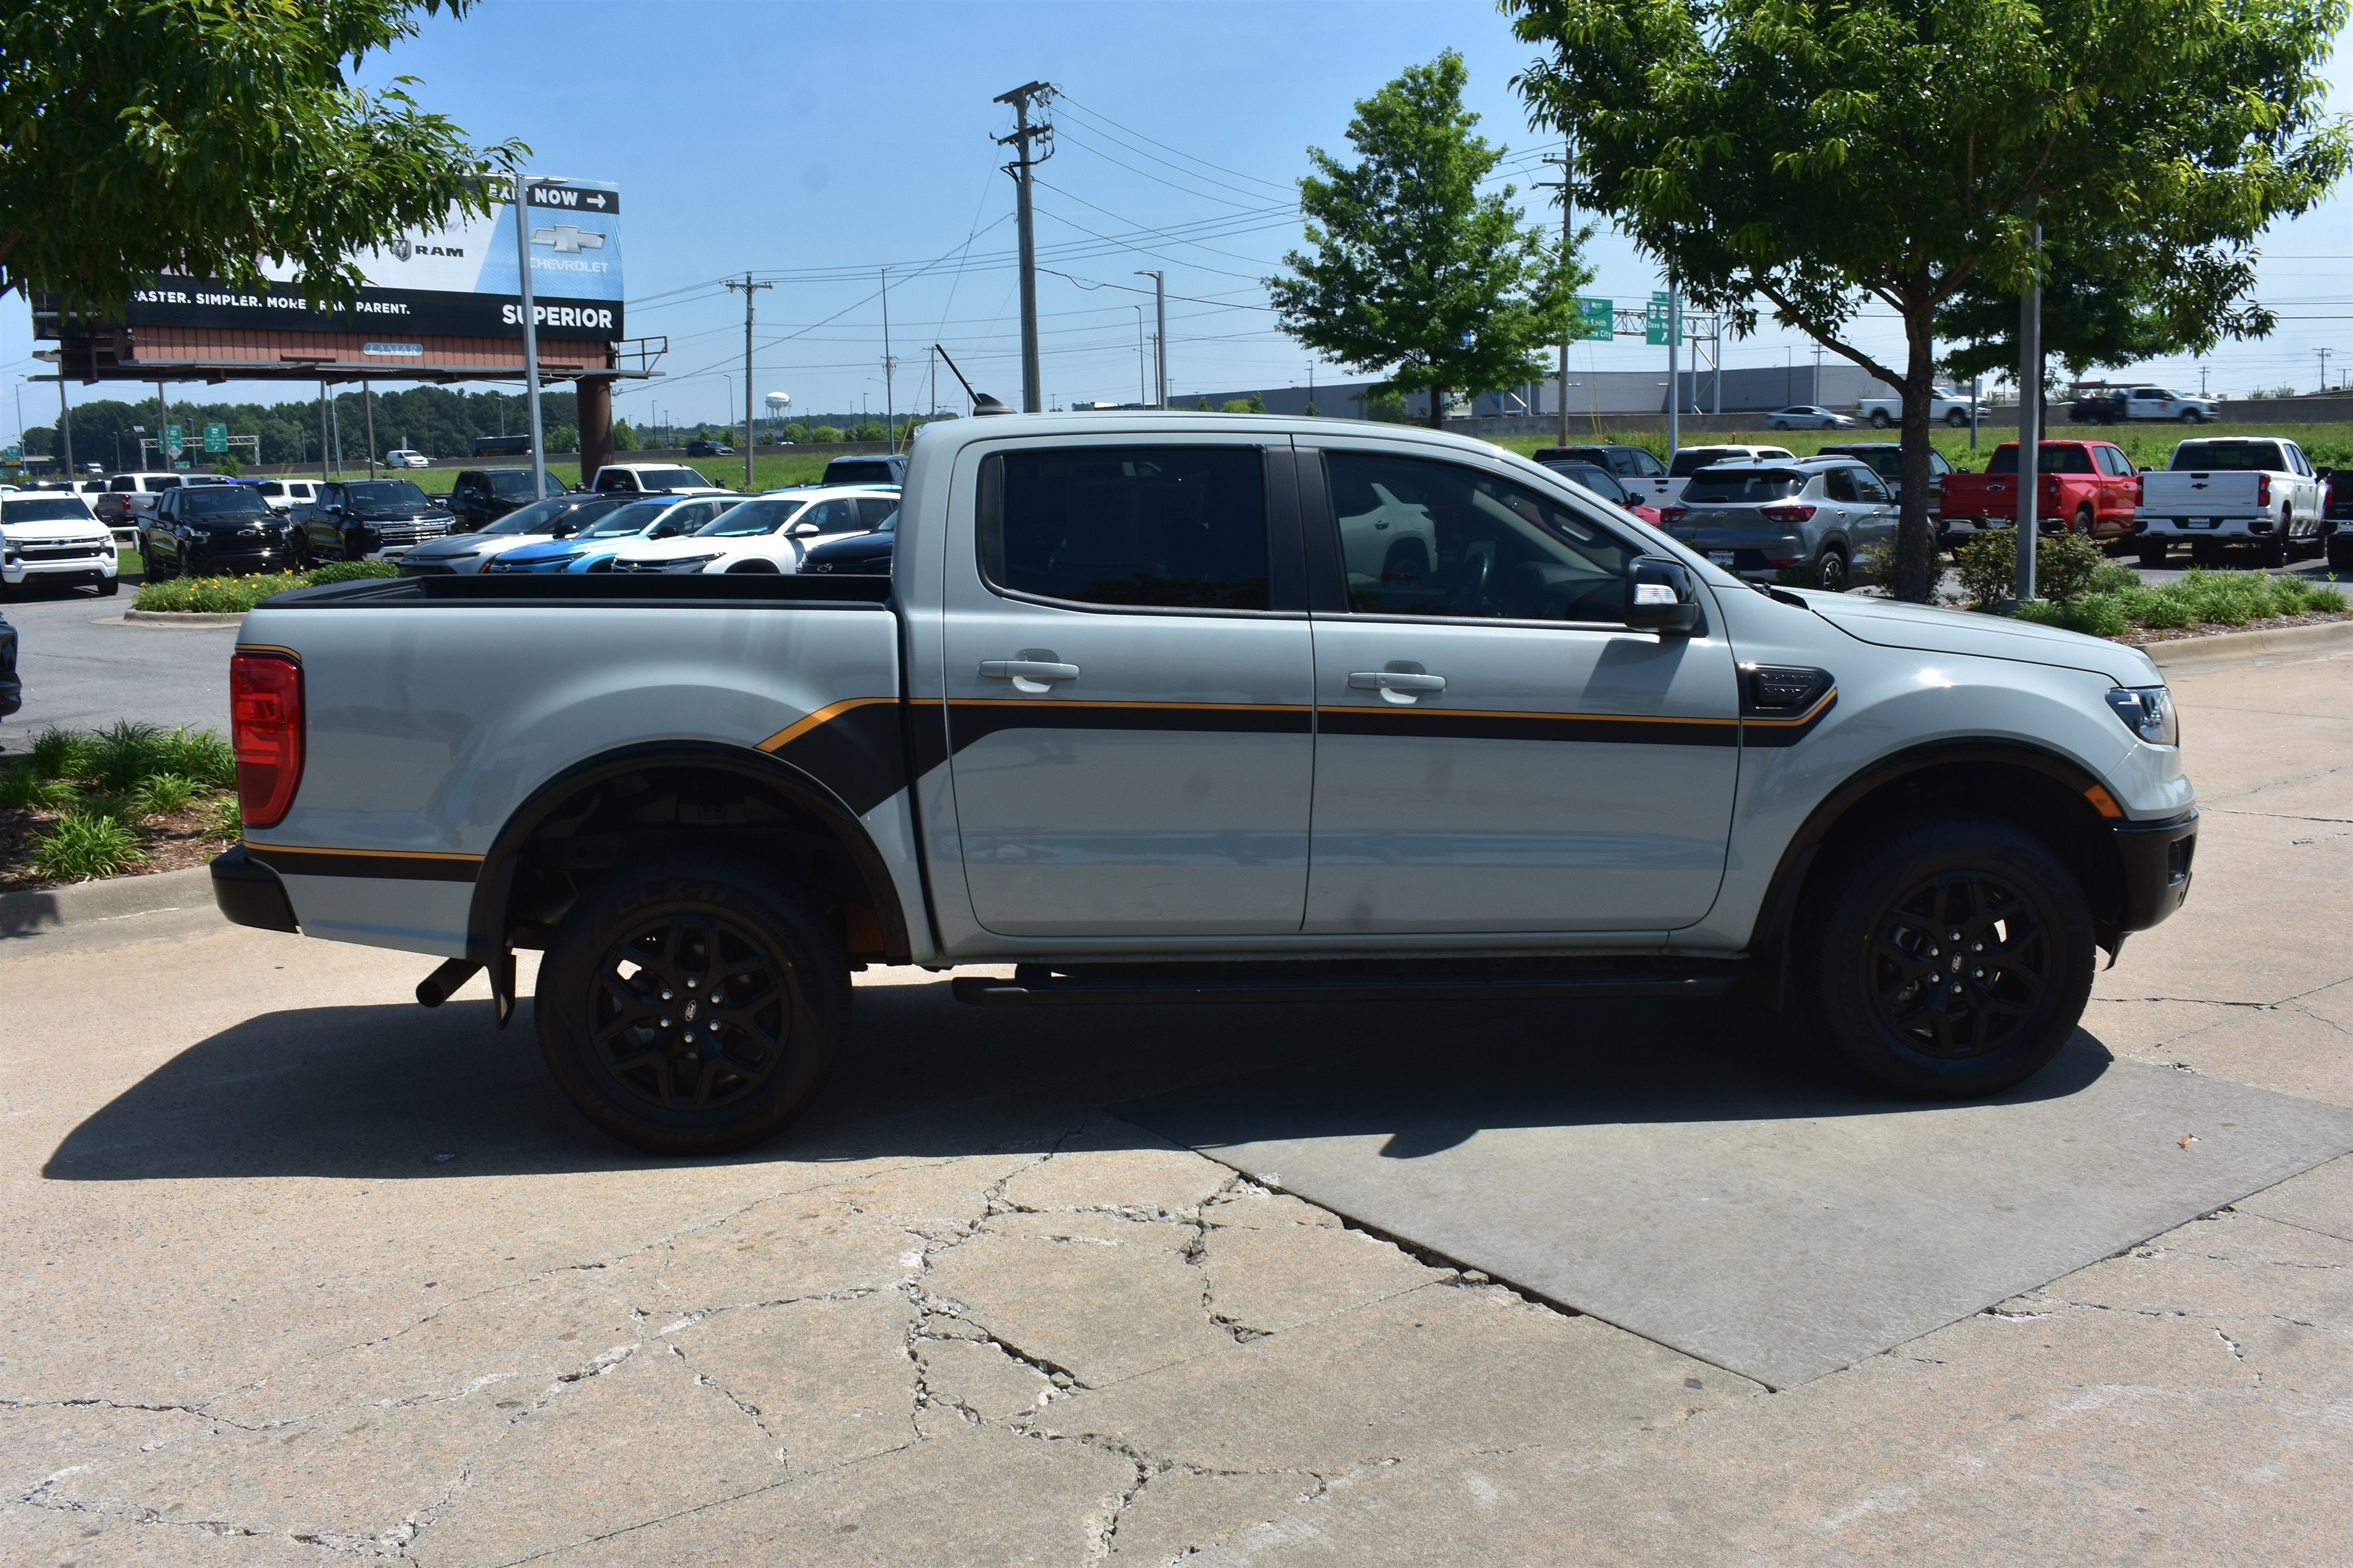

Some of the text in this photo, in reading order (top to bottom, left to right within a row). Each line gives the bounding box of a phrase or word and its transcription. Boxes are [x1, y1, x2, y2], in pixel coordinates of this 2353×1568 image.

[488, 183, 578, 206] EXI NOW
[415, 245, 464, 258] RAM
[530, 257, 608, 273] CHEVROLET
[196, 293, 263, 307] SIMPLER.
[267, 296, 307, 310] MORE
[369, 344, 418, 354] LAMAR
